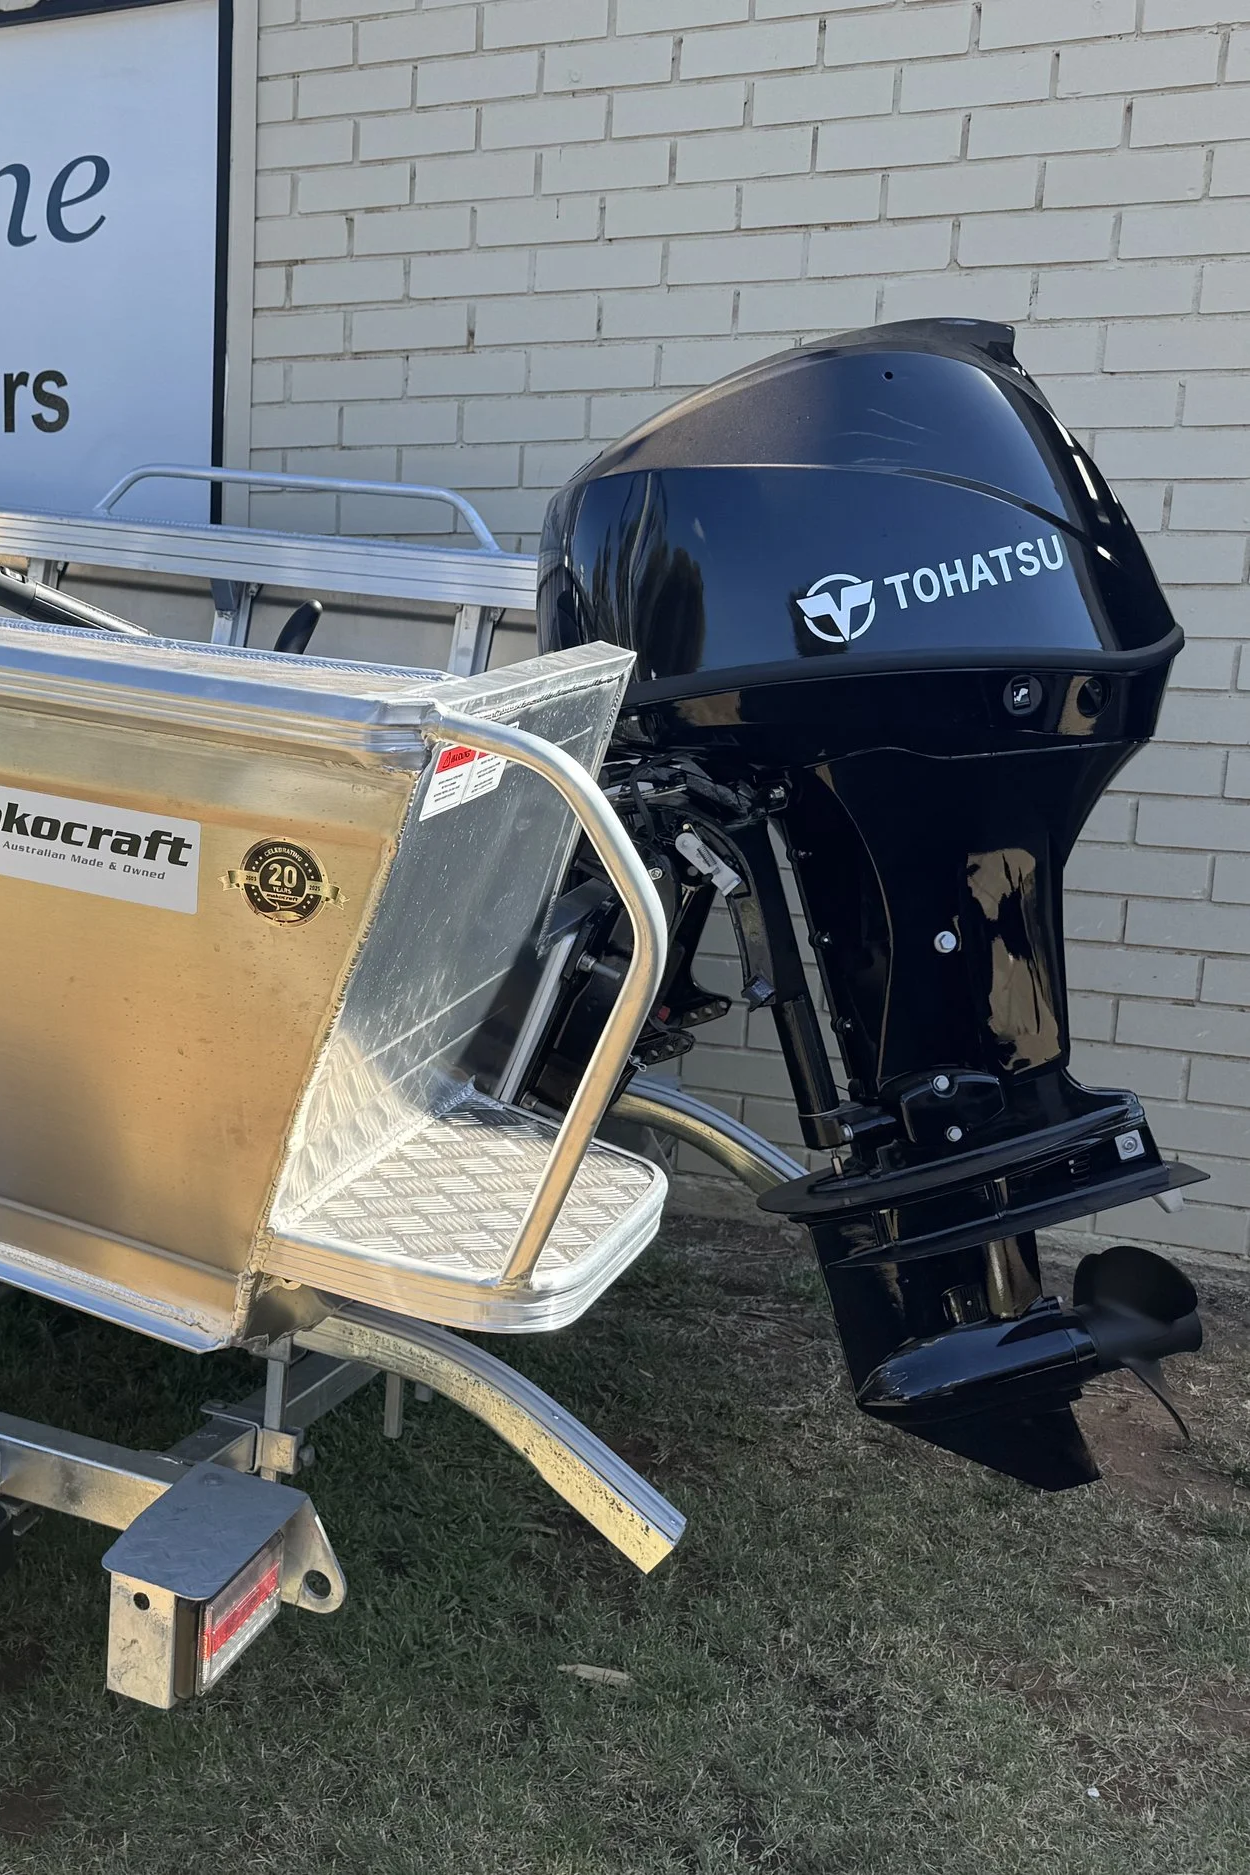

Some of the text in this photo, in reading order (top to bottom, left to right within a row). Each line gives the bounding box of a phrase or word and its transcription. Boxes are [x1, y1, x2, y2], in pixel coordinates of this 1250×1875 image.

[883, 534, 1064, 610] TOHATSU
[2, 839, 67, 861] Australian
[70, 853, 104, 870] Made
[108, 860, 118, 873] &
[122, 863, 167, 881] Owned
[263, 847, 303, 862] CELEBRATING
[268, 863, 298, 888] 20
[272, 886, 292, 895] YEARS
